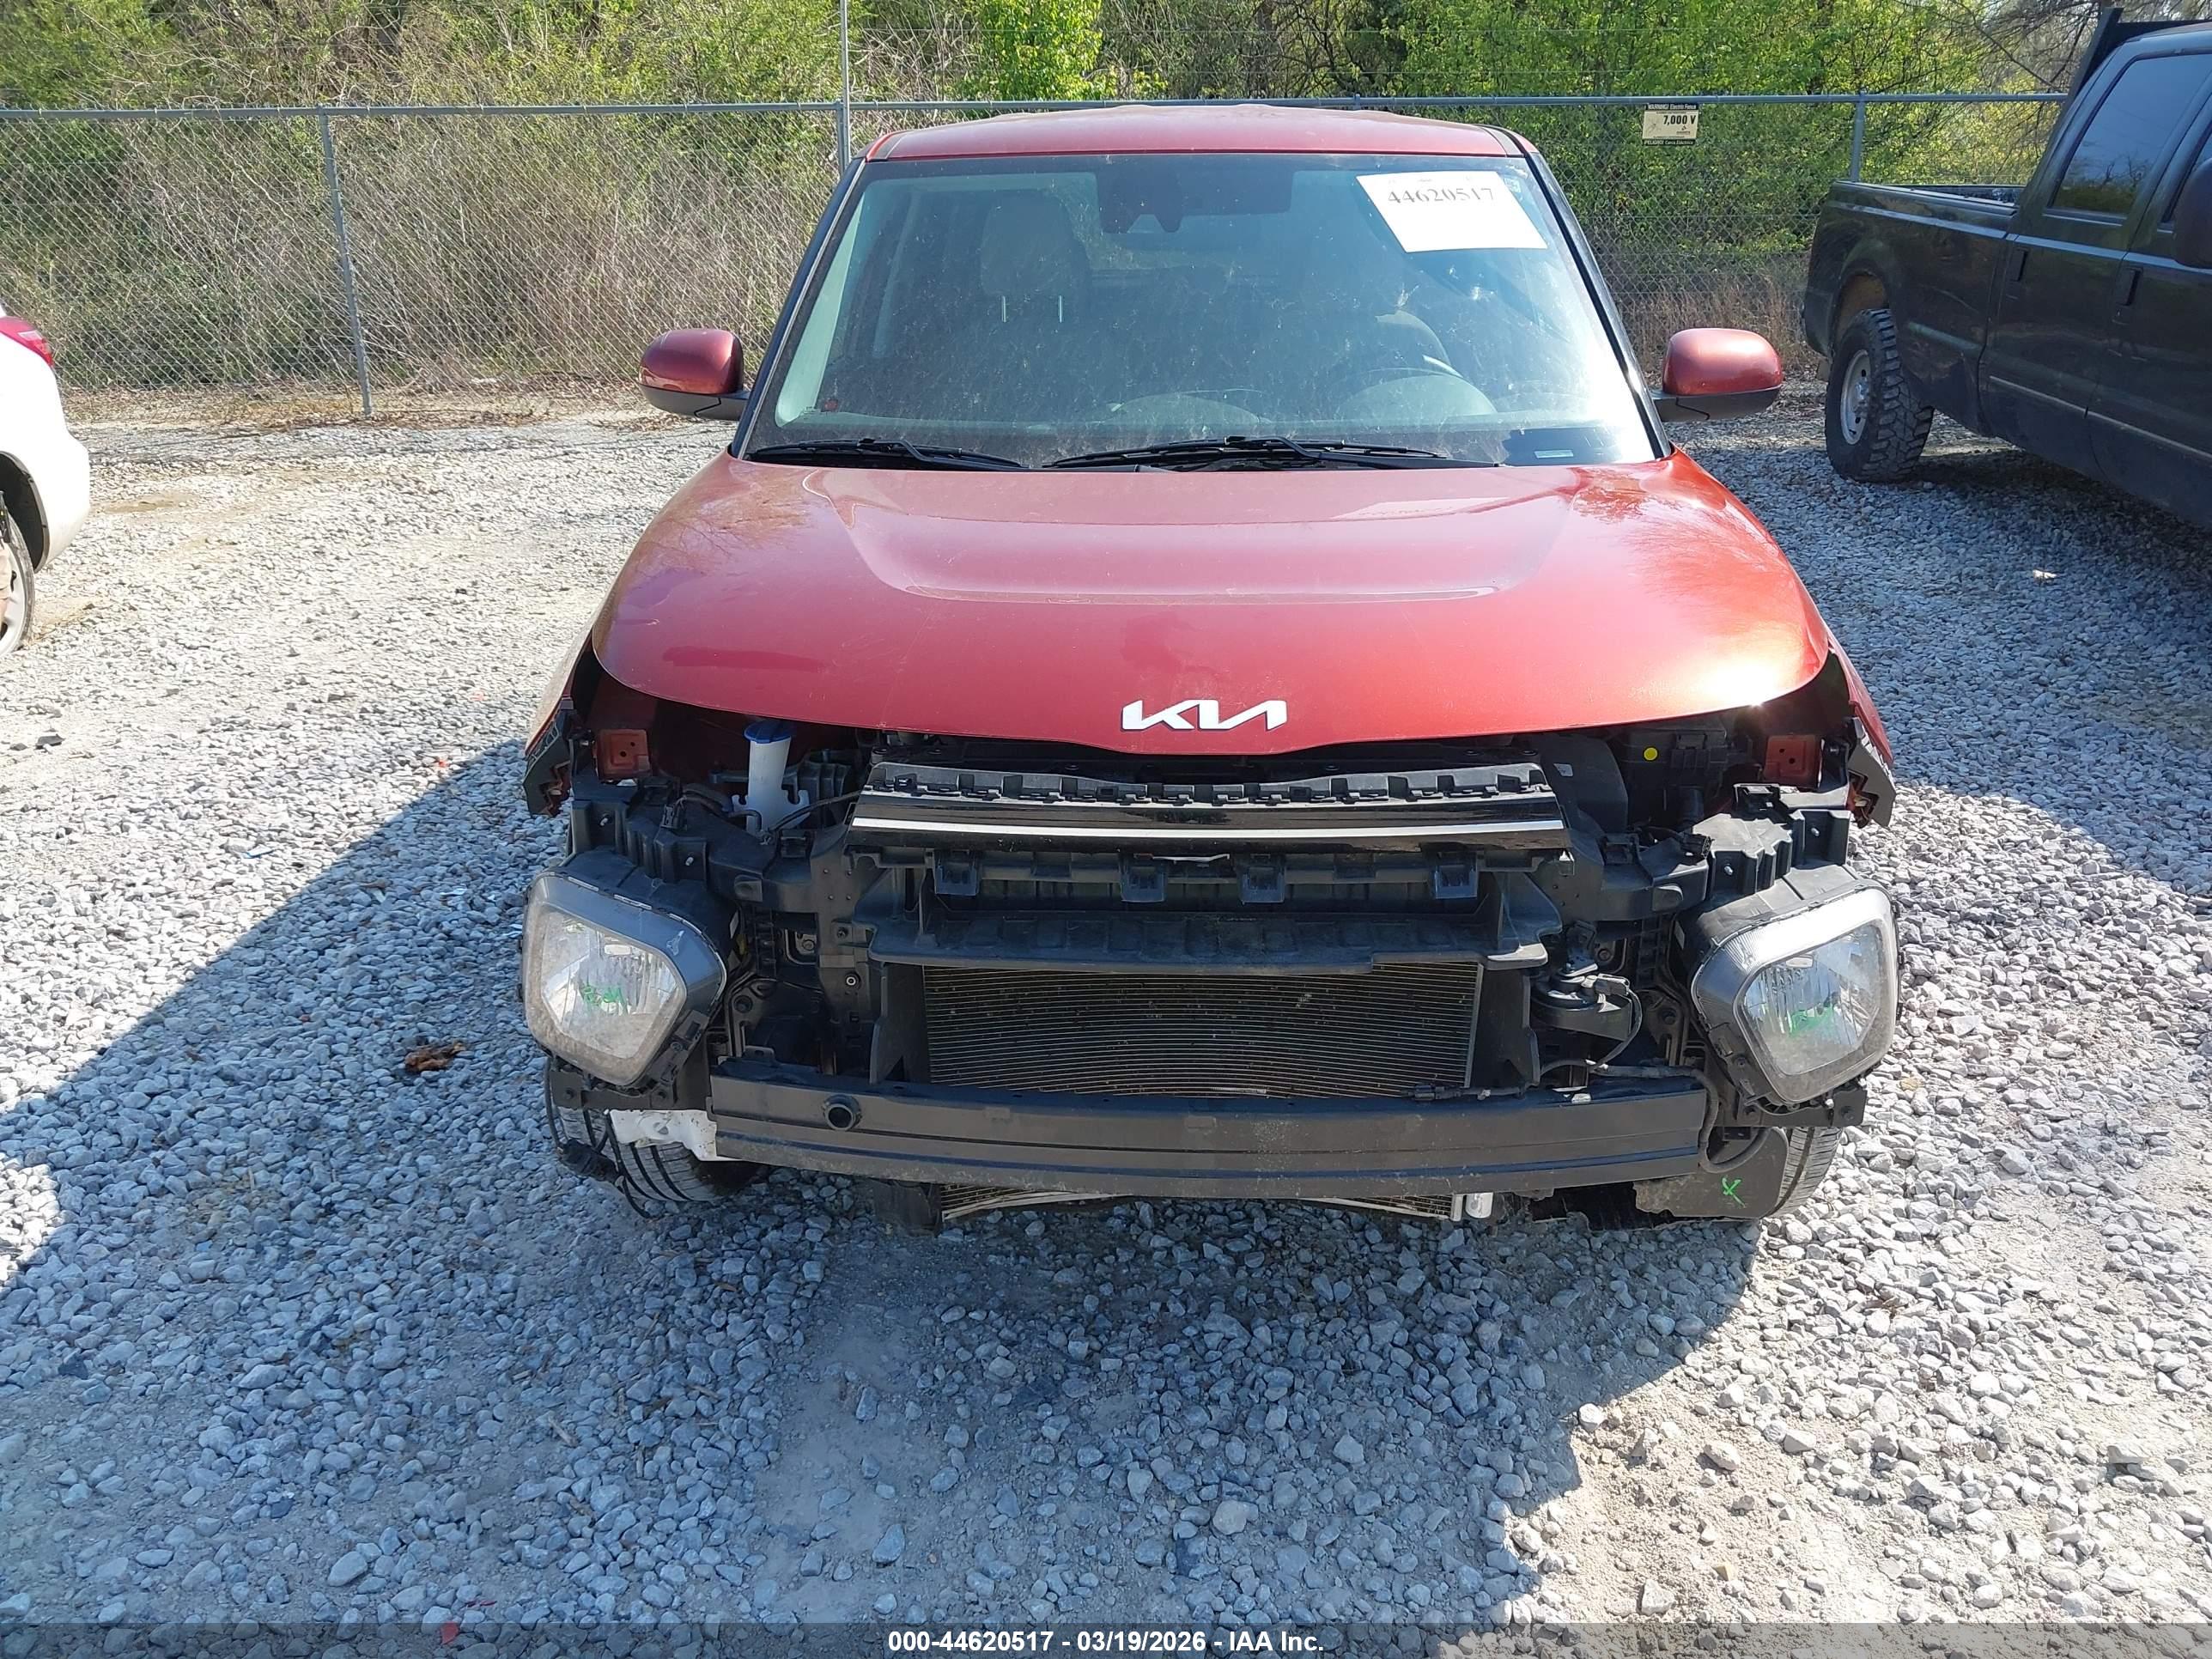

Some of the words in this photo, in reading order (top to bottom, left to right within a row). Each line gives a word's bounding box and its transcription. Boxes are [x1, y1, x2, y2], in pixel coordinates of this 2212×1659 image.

[1663, 115, 1687, 126] 7,000
[1690, 115, 1697, 125] V
[1388, 187, 1493, 204] 44620517
[1122, 699, 1287, 731] KIA
